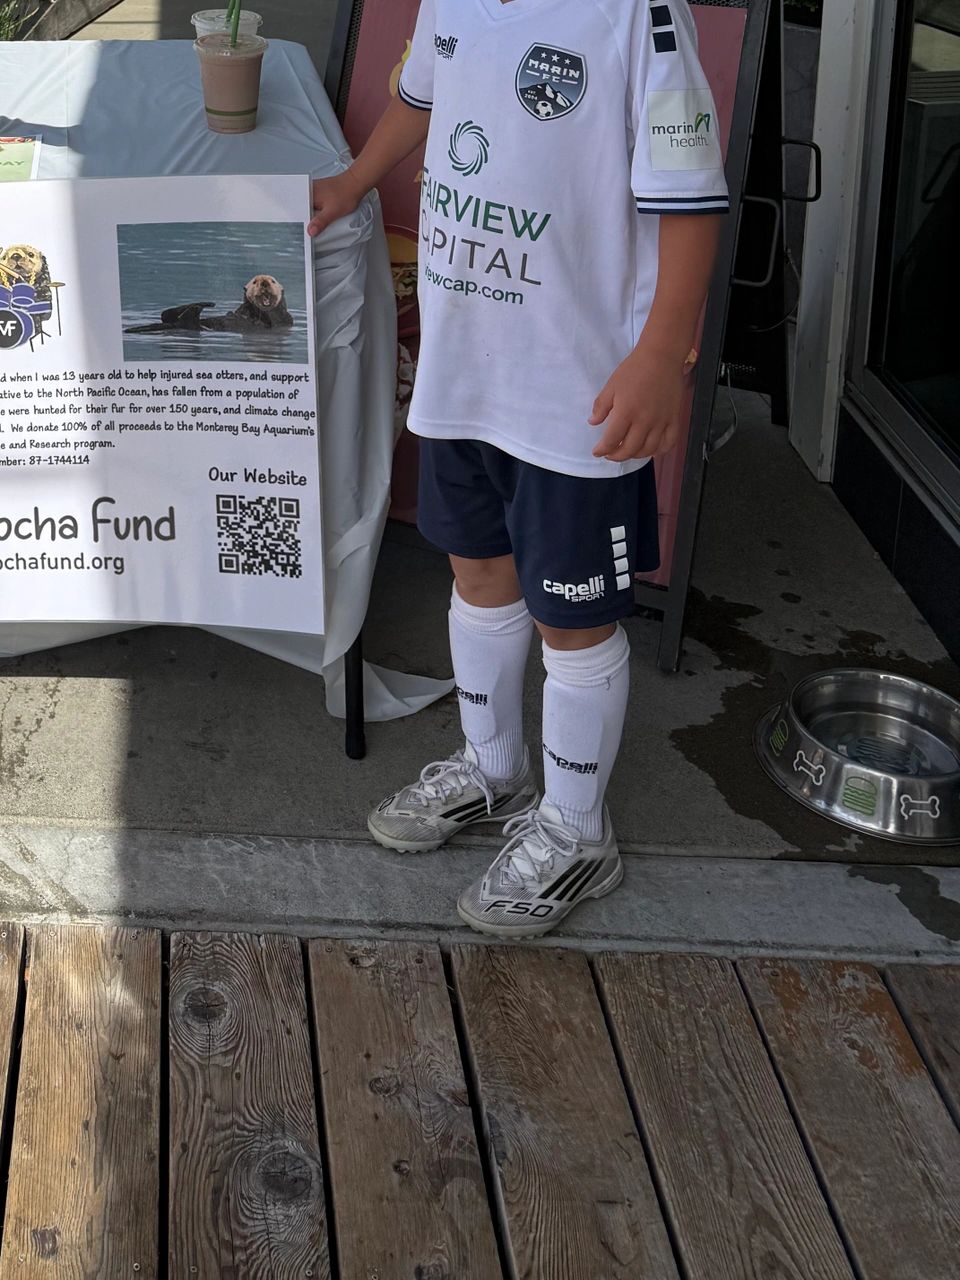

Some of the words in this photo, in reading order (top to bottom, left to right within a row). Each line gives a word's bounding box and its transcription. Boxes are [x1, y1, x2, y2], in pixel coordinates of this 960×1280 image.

[528, 58, 580, 79] MARIN
[542, 73, 560, 83] FC
[652, 121, 694, 135] marin
[669, 134, 707, 148] health
[422, 166, 552, 242] FAIRVIEW
[421, 209, 542, 286] CPITAL
[9, 371, 33, 382] when
[42, 374, 60, 382] was
[62, 371, 76, 381] 13
[78, 371, 105, 383] years
[107, 369, 122, 380] old
[125, 370, 135, 380] to
[137, 369, 157, 382] help
[160, 369, 193, 382] injured
[196, 372, 213, 380] sea
[215, 370, 248, 381] otters,
[249, 370, 268, 381] and
[271, 372, 310, 384] support
[24, 389, 34, 399] to
[37, 388, 53, 398] the
[55, 387, 84, 398] North
[87, 386, 116, 397] Pacific
[118, 386, 150, 398] Ocean,
[152, 386, 169, 397] has
[172, 385, 197, 397] fallen
[200, 385, 223, 397] from
[225, 389, 232, 397] a
[235, 388, 285, 401] population
[288, 388, 299, 400] of
[8, 407, 30, 416] were
[33, 404, 66, 415] hunted
[69, 404, 83, 414] for
[85, 404, 108, 414] their
[111, 403, 125, 413] fur
[129, 403, 143, 413] for
[145, 405, 166, 413] over
[169, 404, 188, 413] 150
[190, 405, 221, 417] years,
[223, 404, 241, 415] and
[244, 405, 278, 416] climate
[281, 407, 316, 420] change
[11, 423, 24, 433] We
[26, 422, 59, 433] donate
[61, 422, 88, 432] 100%
[91, 420, 102, 431] of
[104, 420, 115, 431] all
[119, 421, 162, 434] proceeds
[164, 421, 175, 431] to
[177, 421, 193, 431] the
[196, 422, 239, 436] Monterey
[241, 423, 260, 437] Bay
[263, 424, 315, 437] Aquarium's
[8, 439, 26, 449] and
[29, 439, 71, 449] Research
[74, 440, 115, 451] program.
[29, 455, 90, 466] 87-1744114
[208, 466, 238, 482] Our
[243, 468, 307, 486] Website
[91, 496, 176, 543] Fund
[543, 574, 605, 600] capelli
[571, 591, 605, 603] SPORT
[543, 743, 599, 772] capelli
[484, 900, 554, 918] F50
